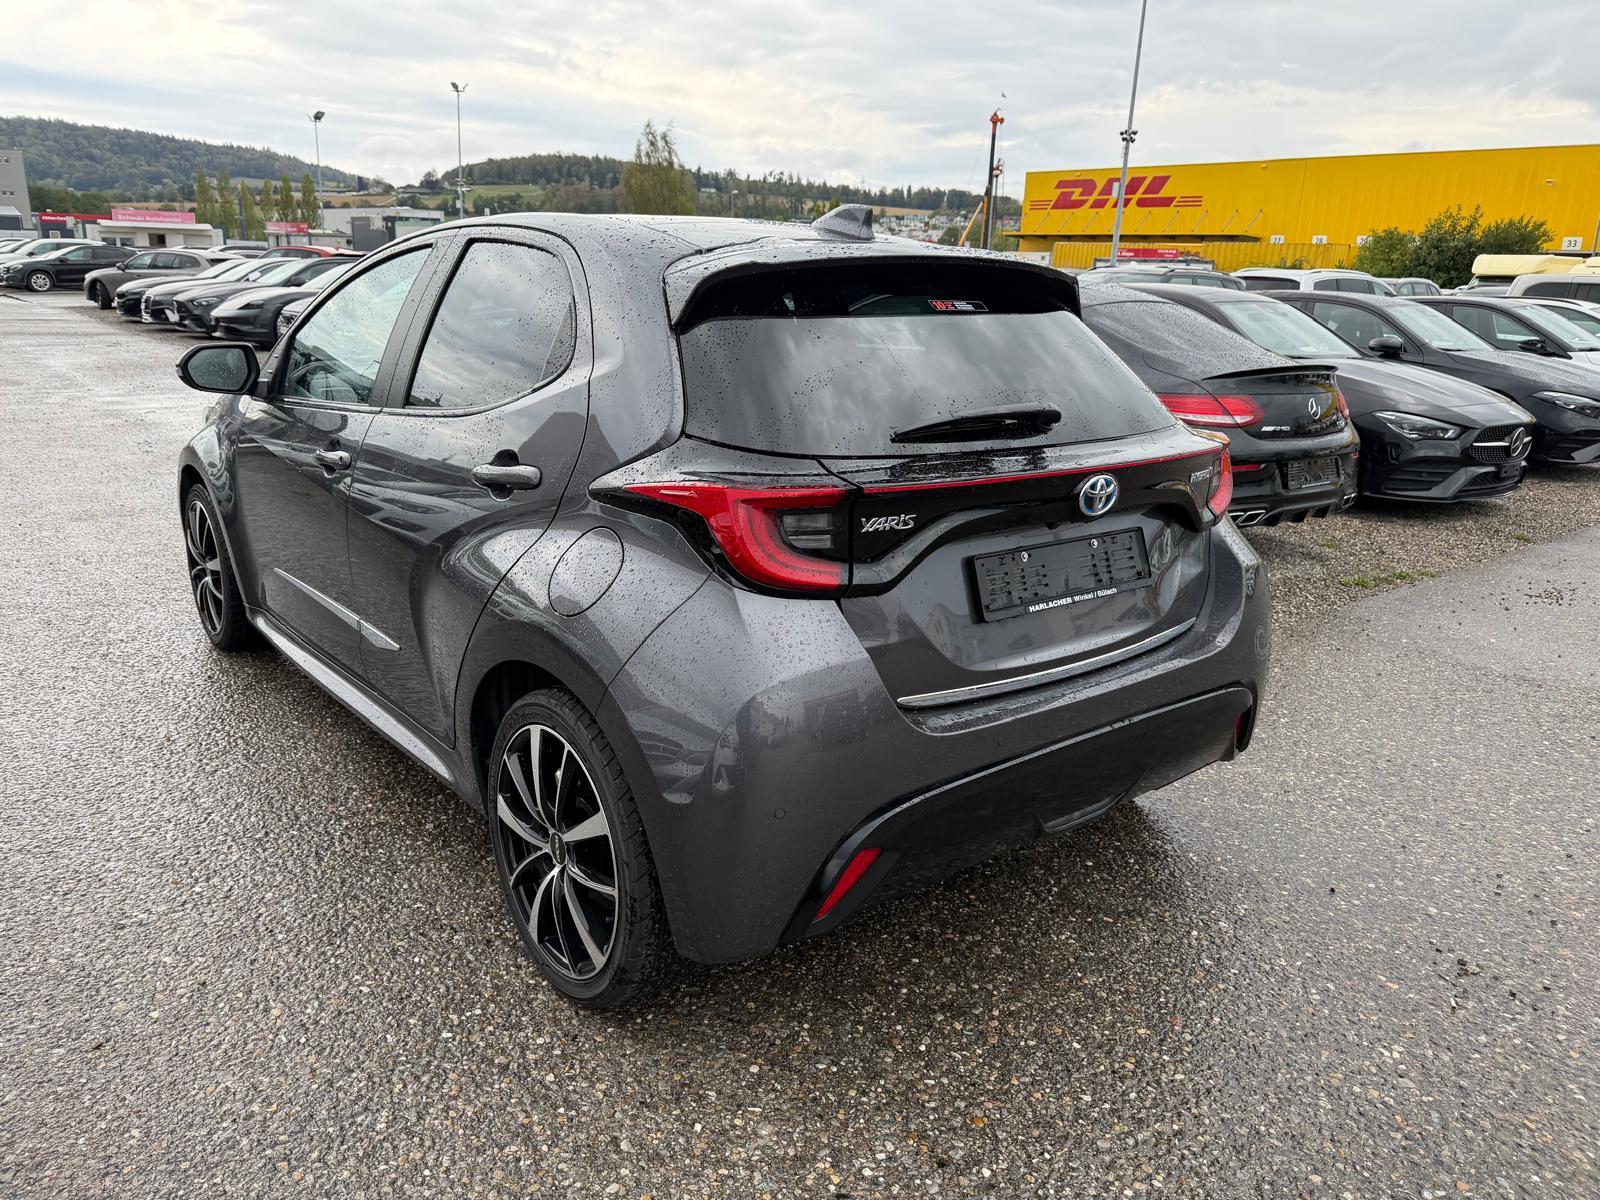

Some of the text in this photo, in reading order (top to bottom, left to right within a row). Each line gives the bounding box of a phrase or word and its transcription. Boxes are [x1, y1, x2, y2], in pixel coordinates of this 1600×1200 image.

[1050, 175, 1178, 210] DHL
[1566, 239, 1578, 248] 33
[1028, 597, 1073, 613] HARLACHER
[1073, 592, 1094, 602] Winkel
[1097, 587, 1118, 597] Bülach
